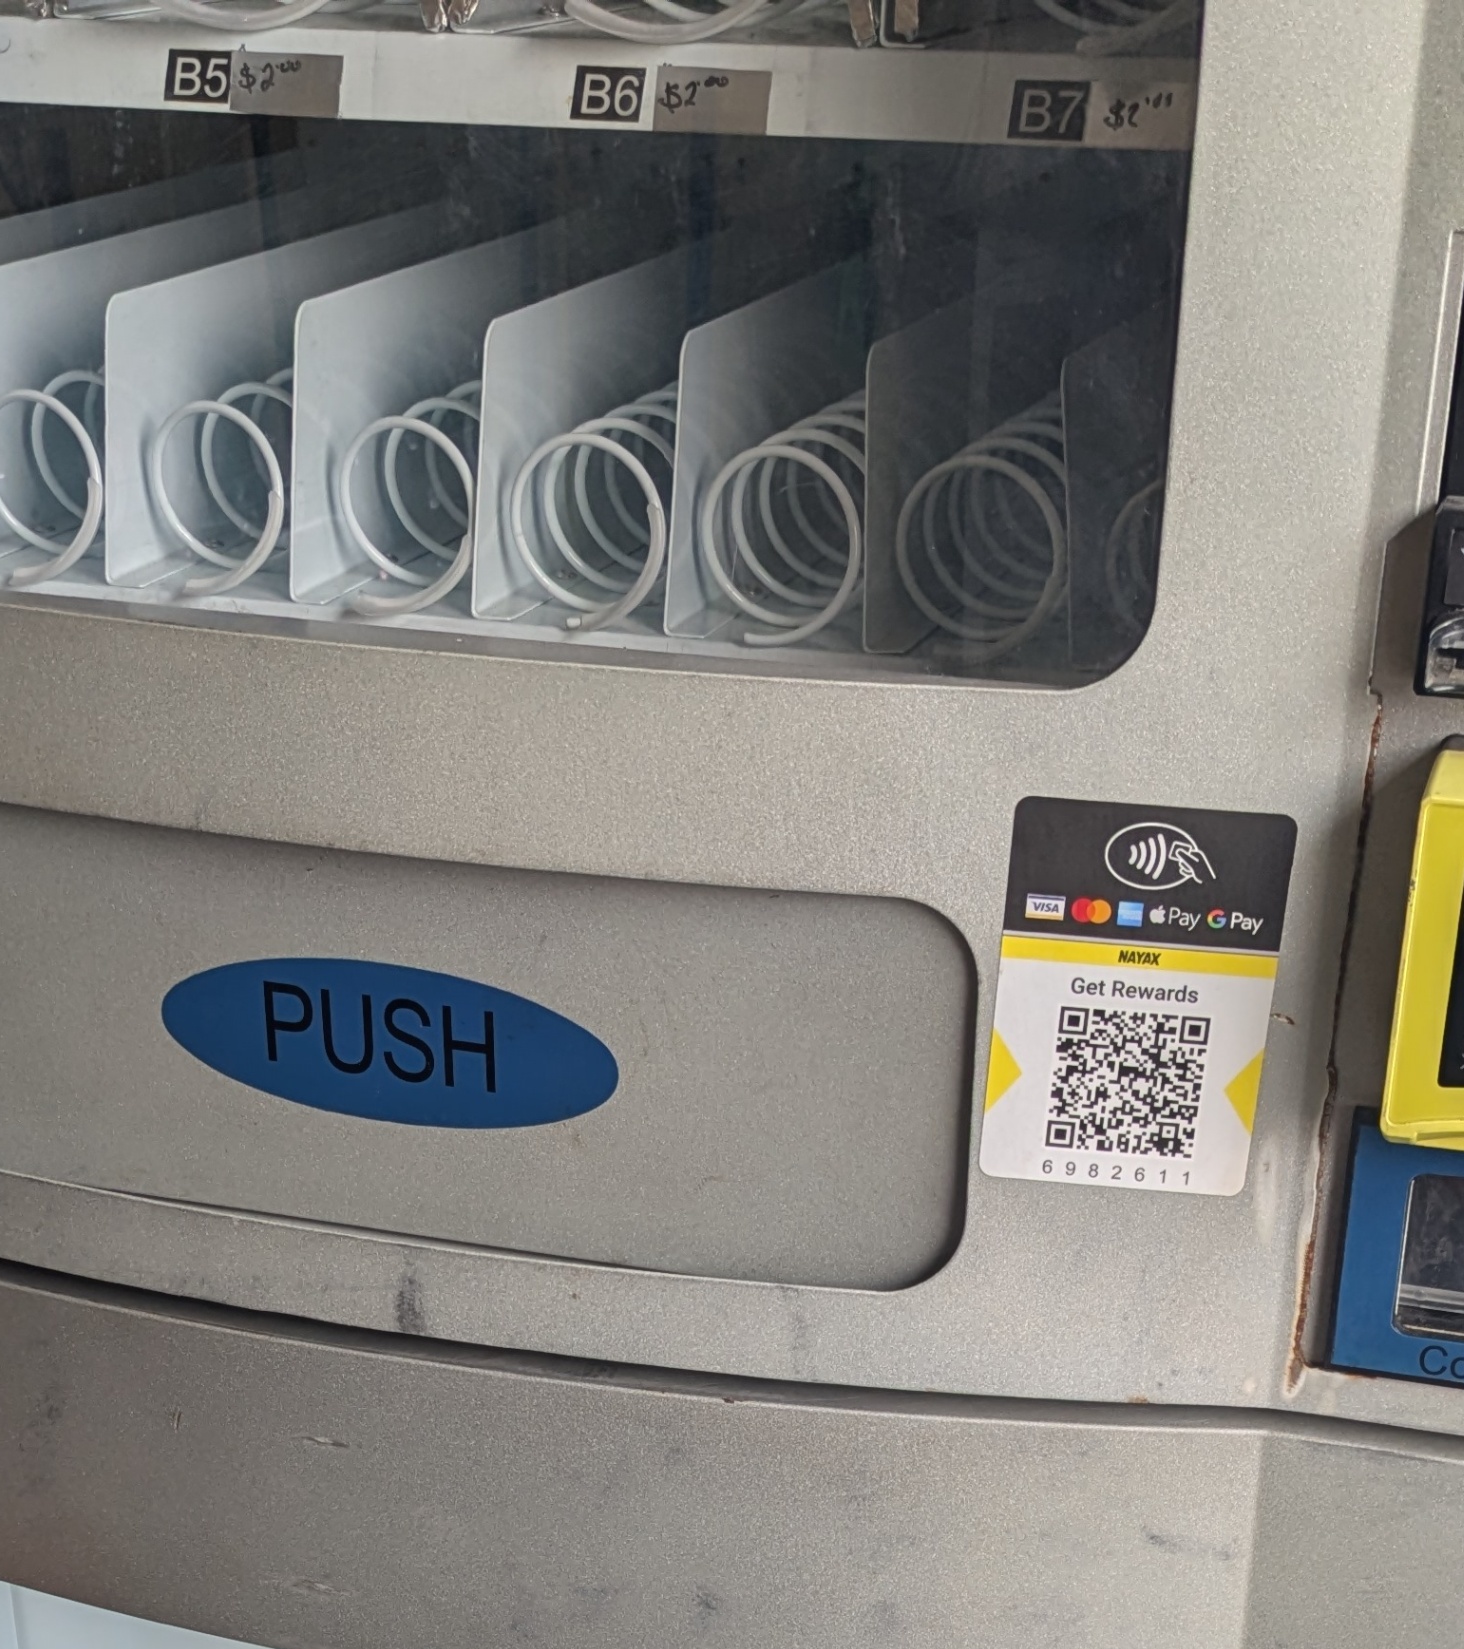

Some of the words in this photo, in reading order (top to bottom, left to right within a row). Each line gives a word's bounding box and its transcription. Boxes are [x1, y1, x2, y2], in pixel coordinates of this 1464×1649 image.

[173, 56, 229, 98] B5
[580, 73, 640, 117] B6
[1019, 88, 1085, 135] B7
[1032, 901, 1060, 914] VISA
[1168, 907, 1201, 931] Pay
[1230, 911, 1264, 935] Pay
[1118, 950, 1162, 966] NAYAX
[1071, 976, 1106, 998] Get
[1111, 979, 1199, 1004] Rewards
[263, 980, 497, 1094] PUSH
